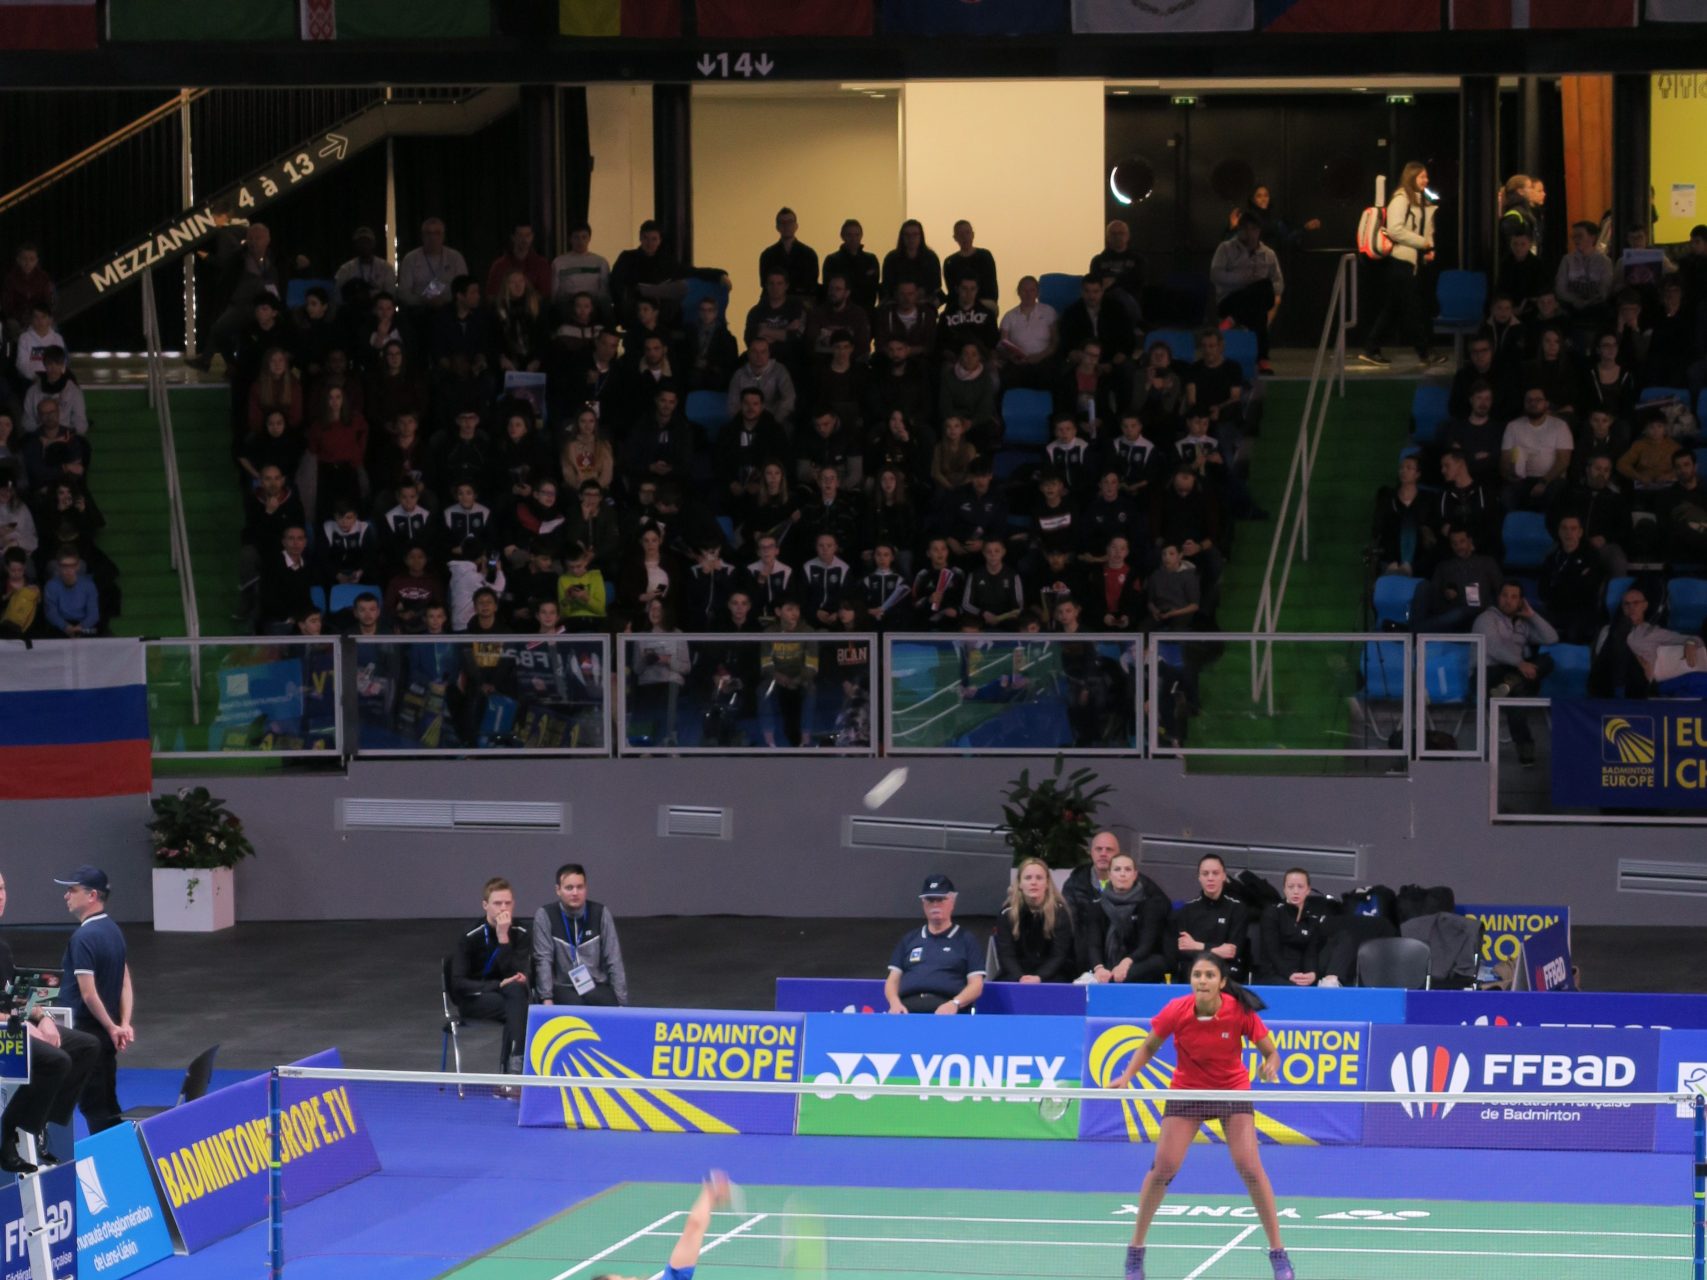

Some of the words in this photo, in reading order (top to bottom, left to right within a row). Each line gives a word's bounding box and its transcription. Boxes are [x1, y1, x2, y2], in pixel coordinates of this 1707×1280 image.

[716, 52, 753, 77] 14
[90, 207, 218, 293] MEZZANIN
[238, 187, 255, 208] 4
[262, 176, 278, 197] à
[283, 153, 315, 183] 13
[1602, 767, 1655, 775] BADMINTON
[1602, 775, 1655, 788] EUROPE
[654, 1022, 797, 1046] BADMINTON
[651, 1045, 795, 1080] EUROPE
[910, 1053, 1066, 1102] YONEX
[1481, 1108, 1499, 1120] de
[1504, 1108, 1581, 1121] Badminton
[5, 1200, 73, 1263] FFaD
